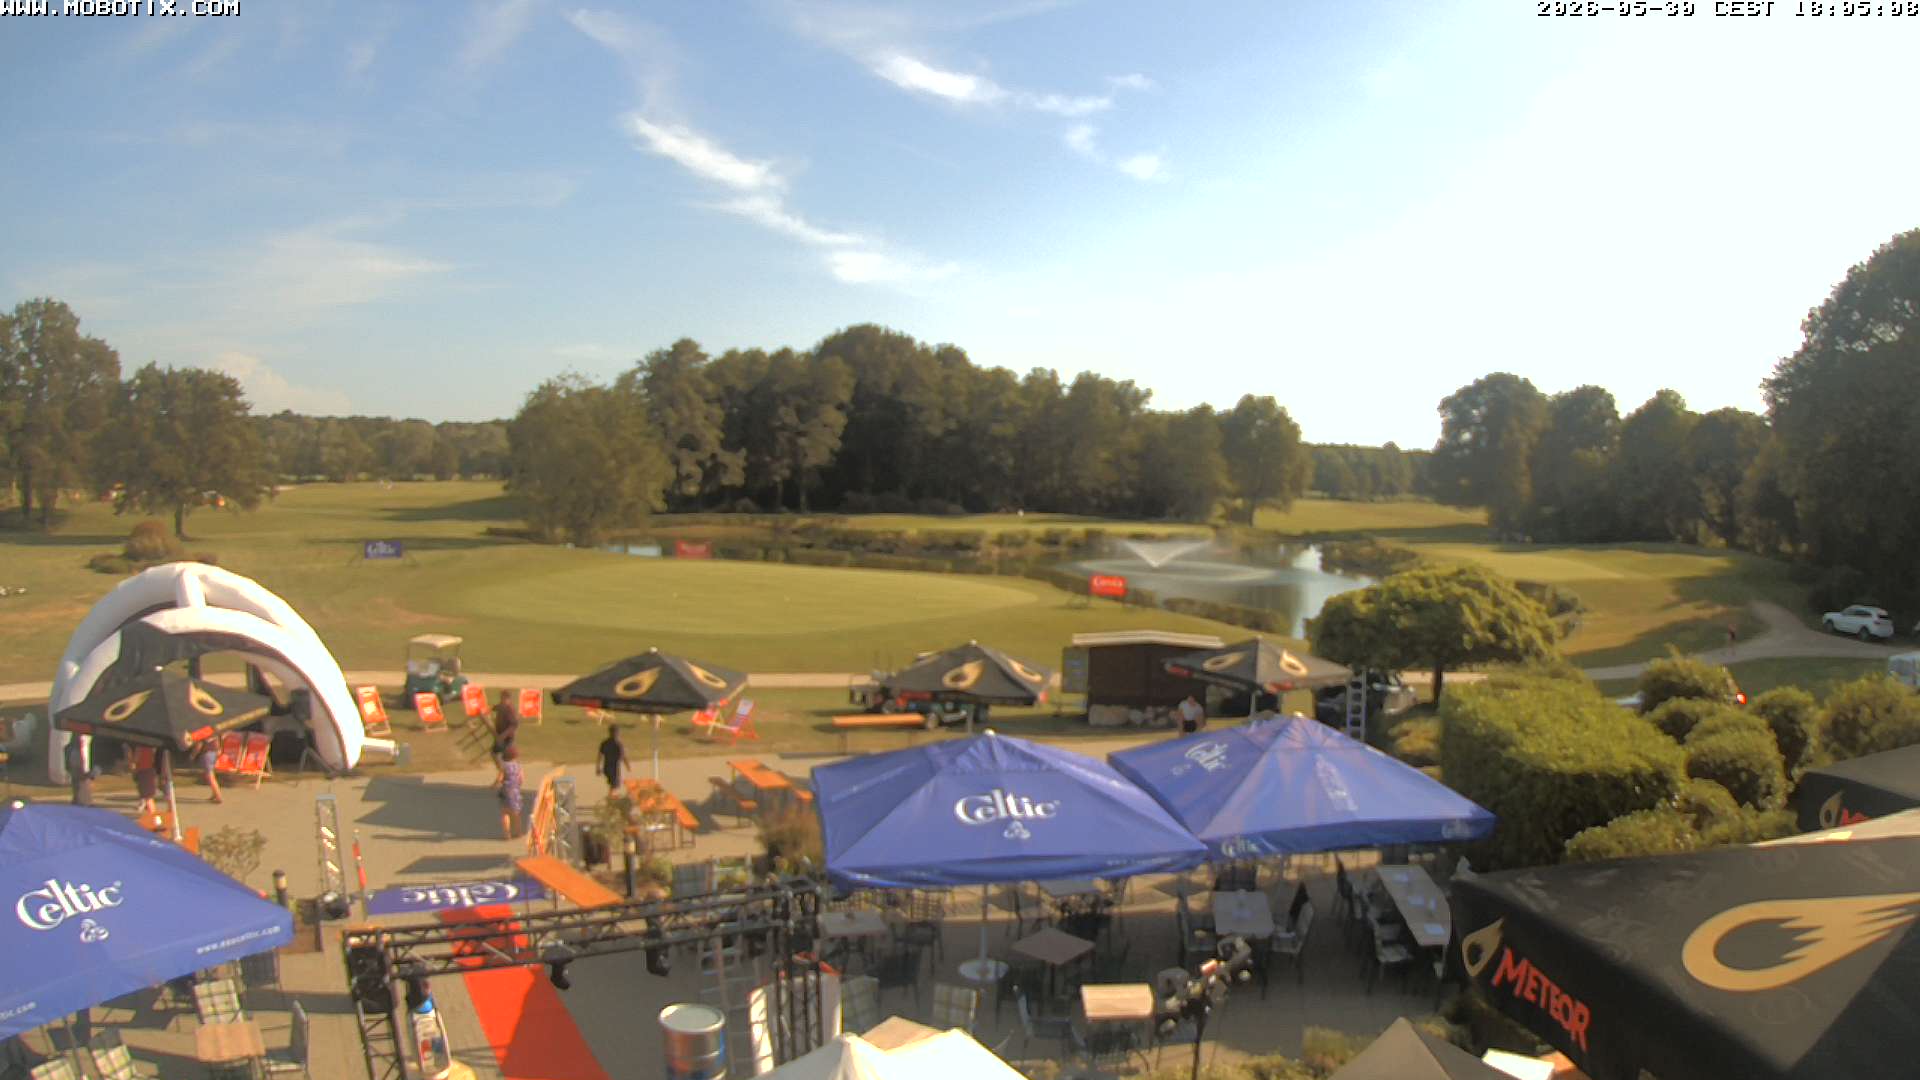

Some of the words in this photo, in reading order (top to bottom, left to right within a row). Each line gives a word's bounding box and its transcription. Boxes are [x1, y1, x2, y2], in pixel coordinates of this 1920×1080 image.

[954, 787, 1060, 824] Celtic
[16, 879, 124, 930] Celtic
[401, 882, 519, 908] Celtic
[1491, 945, 1591, 1053] METEOR
